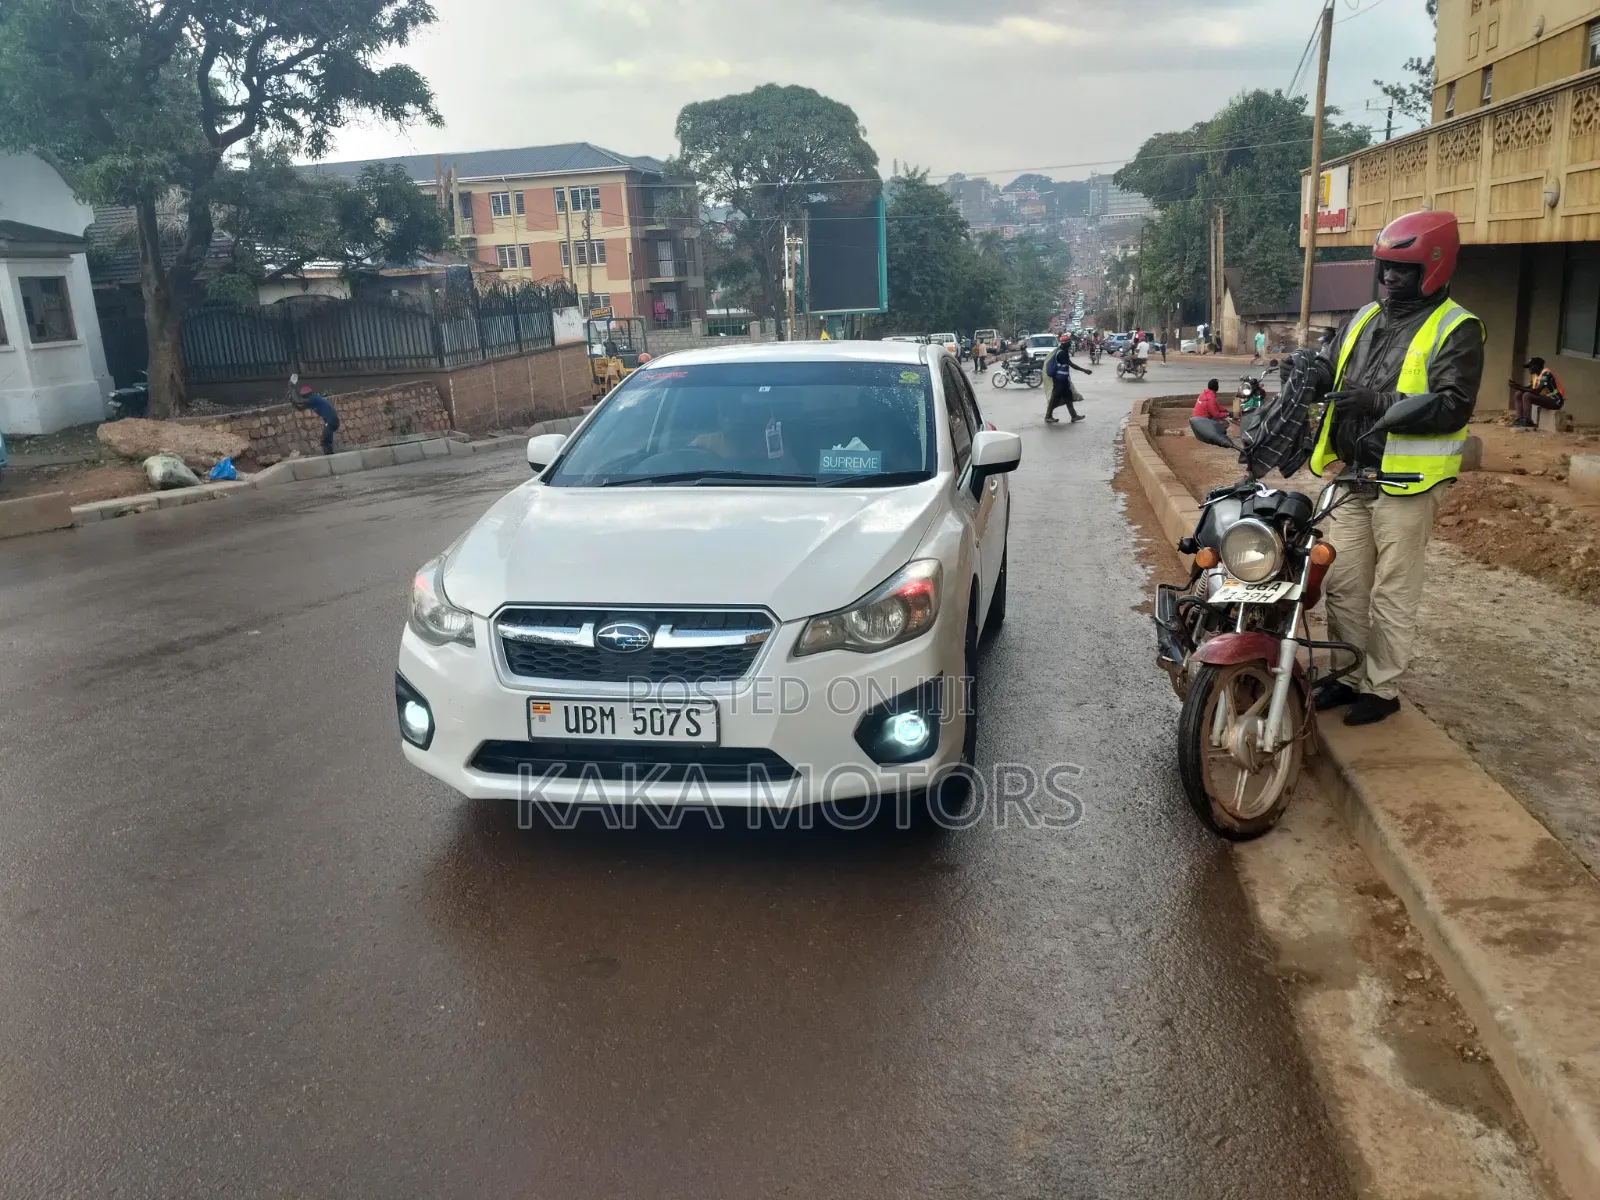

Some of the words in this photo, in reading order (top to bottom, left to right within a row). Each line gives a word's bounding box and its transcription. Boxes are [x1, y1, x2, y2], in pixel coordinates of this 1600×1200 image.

[822, 456, 878, 469] SUPREME
[1223, 591, 1274, 602] 129H
[563, 705, 616, 735] UBM
[631, 707, 703, 738] 507S
